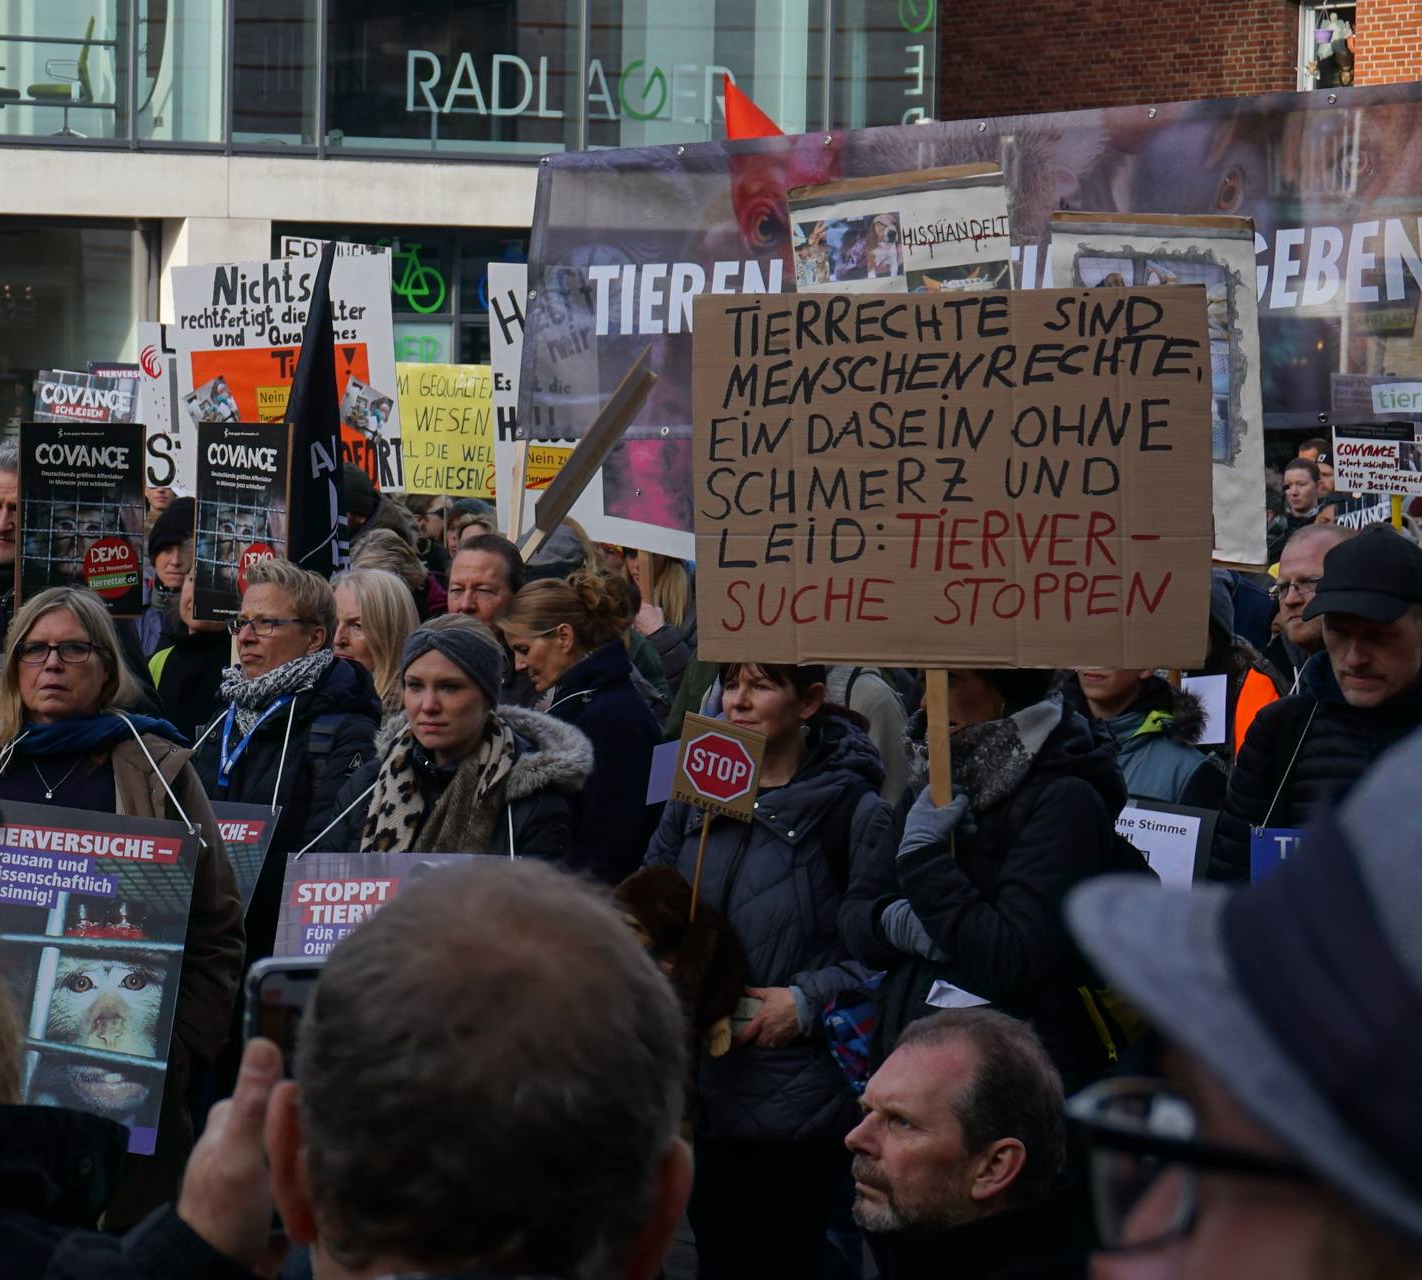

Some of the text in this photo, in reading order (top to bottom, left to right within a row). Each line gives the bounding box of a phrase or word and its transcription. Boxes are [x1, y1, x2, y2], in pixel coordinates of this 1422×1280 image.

[212, 262, 311, 306] Nichts
[180, 300, 366, 337] rechtfertigt die lter
[725, 292, 1164, 358] TIERRECHTE SIND
[213, 328, 245, 347] und
[98, 369, 140, 379] TIERVERS
[494, 373, 511, 391] Es
[722, 335, 1202, 409] MENSCHENRECHTE,
[420, 371, 492, 398] GEQUÄLTE
[41, 383, 131, 413] COVANCE
[259, 391, 285, 404] Nein
[1378, 388, 1422, 409] tier
[55, 404, 104, 418] SCHLIESSEN!
[415, 406, 490, 436] WESEN
[709, 393, 1173, 463] EIN DASEIN OHNE
[35, 443, 129, 470] COVANCE
[207, 442, 278, 472] COVANCE
[426, 442, 449, 459] DIE
[462, 444, 493, 463] WEL
[41, 470, 76, 479] Deutschlands
[96, 472, 124, 480] Affenlabor
[1338, 468, 1364, 479] Keine
[701, 456, 1120, 520] SCHMERZ UND
[1348, 480, 1363, 489] Ihr
[90, 545, 129, 563] DEMO
[106, 563, 133, 571] November
[722, 571, 1172, 632] SUCHE STOPPEN
[691, 747, 747, 785] STOP
[1139, 819, 1187, 836] Stimme
[57, 857, 88, 873] und
[298, 881, 391, 903] STOPPT
[305, 925, 334, 940] FÜR
